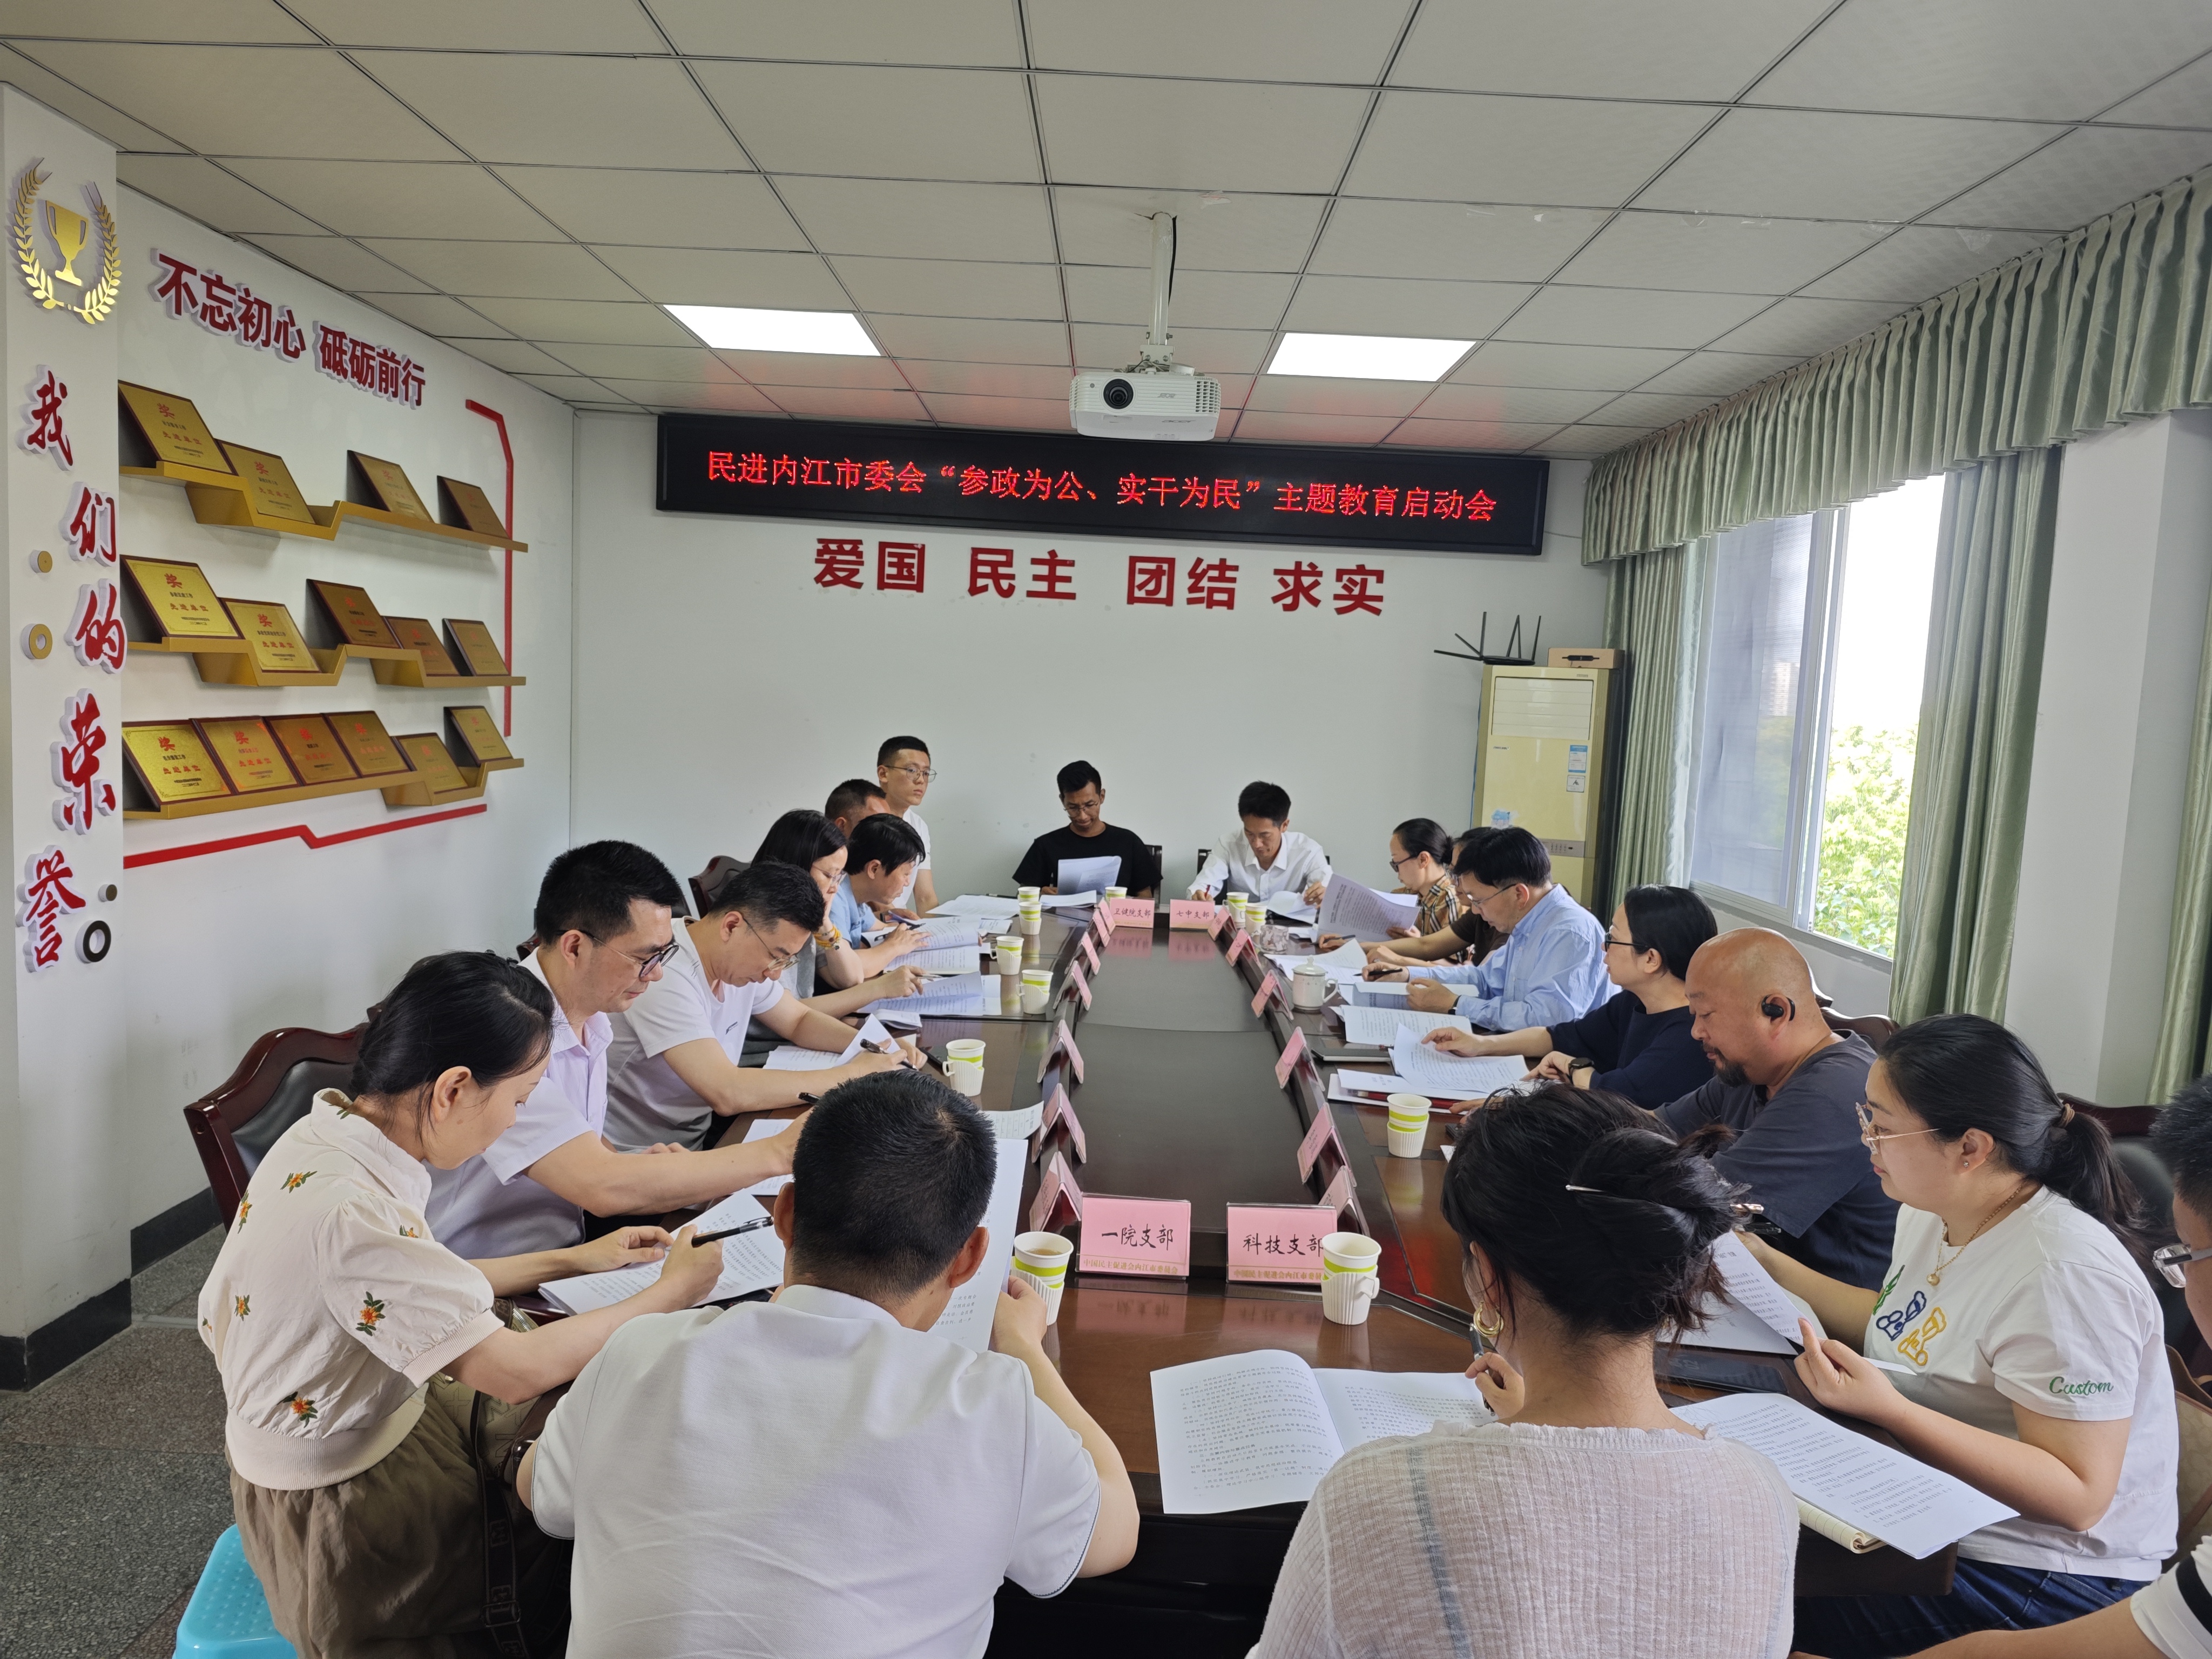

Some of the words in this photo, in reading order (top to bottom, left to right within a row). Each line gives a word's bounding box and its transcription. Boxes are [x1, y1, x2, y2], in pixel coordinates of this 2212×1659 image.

[158, 253, 306, 359] 不忘初心
[320, 325, 426, 406] 砥砺前行
[157, 402, 175, 420] 奖
[163, 430, 202, 446] 先进单位
[164, 572, 183, 589] 奖
[814, 538, 925, 593] 爱国
[968, 547, 1076, 600] 民主
[1127, 556, 1239, 610] 团结
[1271, 561, 1384, 616] 求实
[170, 602, 209, 612] 先进单位
[257, 613, 273, 628] 奖
[157, 736, 176, 752] 奖
[163, 764, 201, 775] 先进单位
[1176, 909, 1210, 920] 七中支部
[1101, 1223, 1174, 1251] 一院支部
[1242, 1232, 1324, 1258] 科技支部
[1083, 1258, 1179, 1275] 中国民主促进会内江市委员会
[2049, 1376, 2114, 1396] Custom
